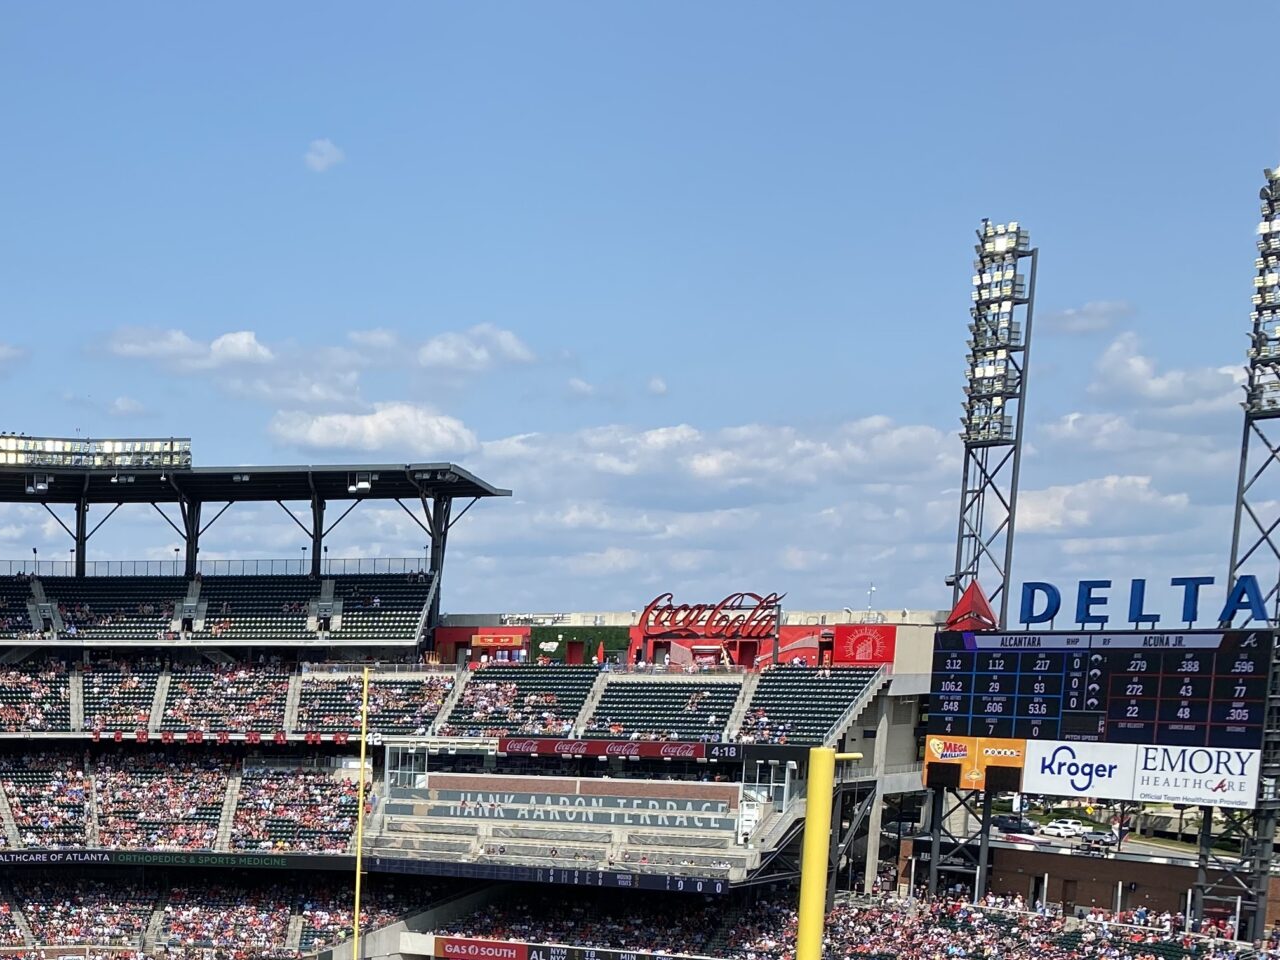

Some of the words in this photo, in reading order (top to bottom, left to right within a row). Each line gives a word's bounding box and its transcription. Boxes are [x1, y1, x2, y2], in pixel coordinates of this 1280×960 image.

[1020, 575, 1269, 624] DELTA
[1000, 636, 1041, 647] ALCANTARA
[1066, 638, 1079, 646] RHP
[1102, 638, 1111, 646] RF
[946, 660, 961, 670] 3.12
[988, 660, 1005, 670] 1.12
[1033, 660, 1050, 670] .217
[1074, 658, 1080, 668] 0
[1127, 661, 1147, 672] .279
[1177, 661, 1200, 672] .388
[1231, 662, 1254, 672] .596
[941, 682, 962, 691] 106.2
[989, 682, 1000, 692] 29
[1034, 683, 1045, 693] 93
[1072, 678, 1078, 688] 0
[1126, 685, 1143, 695] 272
[1180, 686, 1192, 696] 43
[1234, 686, 1247, 697] 77
[941, 702, 959, 711] .648
[984, 703, 1002, 713] .606
[1070, 698, 1076, 708] 0
[1028, 704, 1046, 714] 53.6
[1126, 706, 1139, 717] 22
[1177, 708, 1190, 719] 48
[1226, 709, 1249, 720] .305
[946, 723, 951, 733] 4
[988, 725, 994, 735] 7
[1032, 726, 1039, 736] 0
[365, 733, 382, 745] 42
[711, 746, 736, 757] 4:18
[942, 742, 967, 753] MEGA
[1142, 747, 1254, 776] EMORY
[1040, 746, 1118, 792] Kroger
[1140, 776, 1246, 792] HEALTHCARE
[1140, 793, 1162, 801] Official
[1163, 794, 1181, 802] Team
[1182, 796, 1218, 804] Healthcare
[1219, 798, 1248, 806] Provider
[450, 792, 515, 818] HANK
[517, 795, 596, 822] AARON
[609, 799, 727, 829] TERRACE
[50, 854, 63, 862] OF
[118, 854, 186, 864] ORTHOPEDICS
[188, 856, 195, 864] &
[198, 856, 236, 865] SPORTS
[239, 858, 287, 866] MEDICINE
[697, 882, 703, 892] 0
[716, 883, 722, 893] 0
[444, 943, 469, 955] GAS
[479, 947, 516, 959] SOUTH
